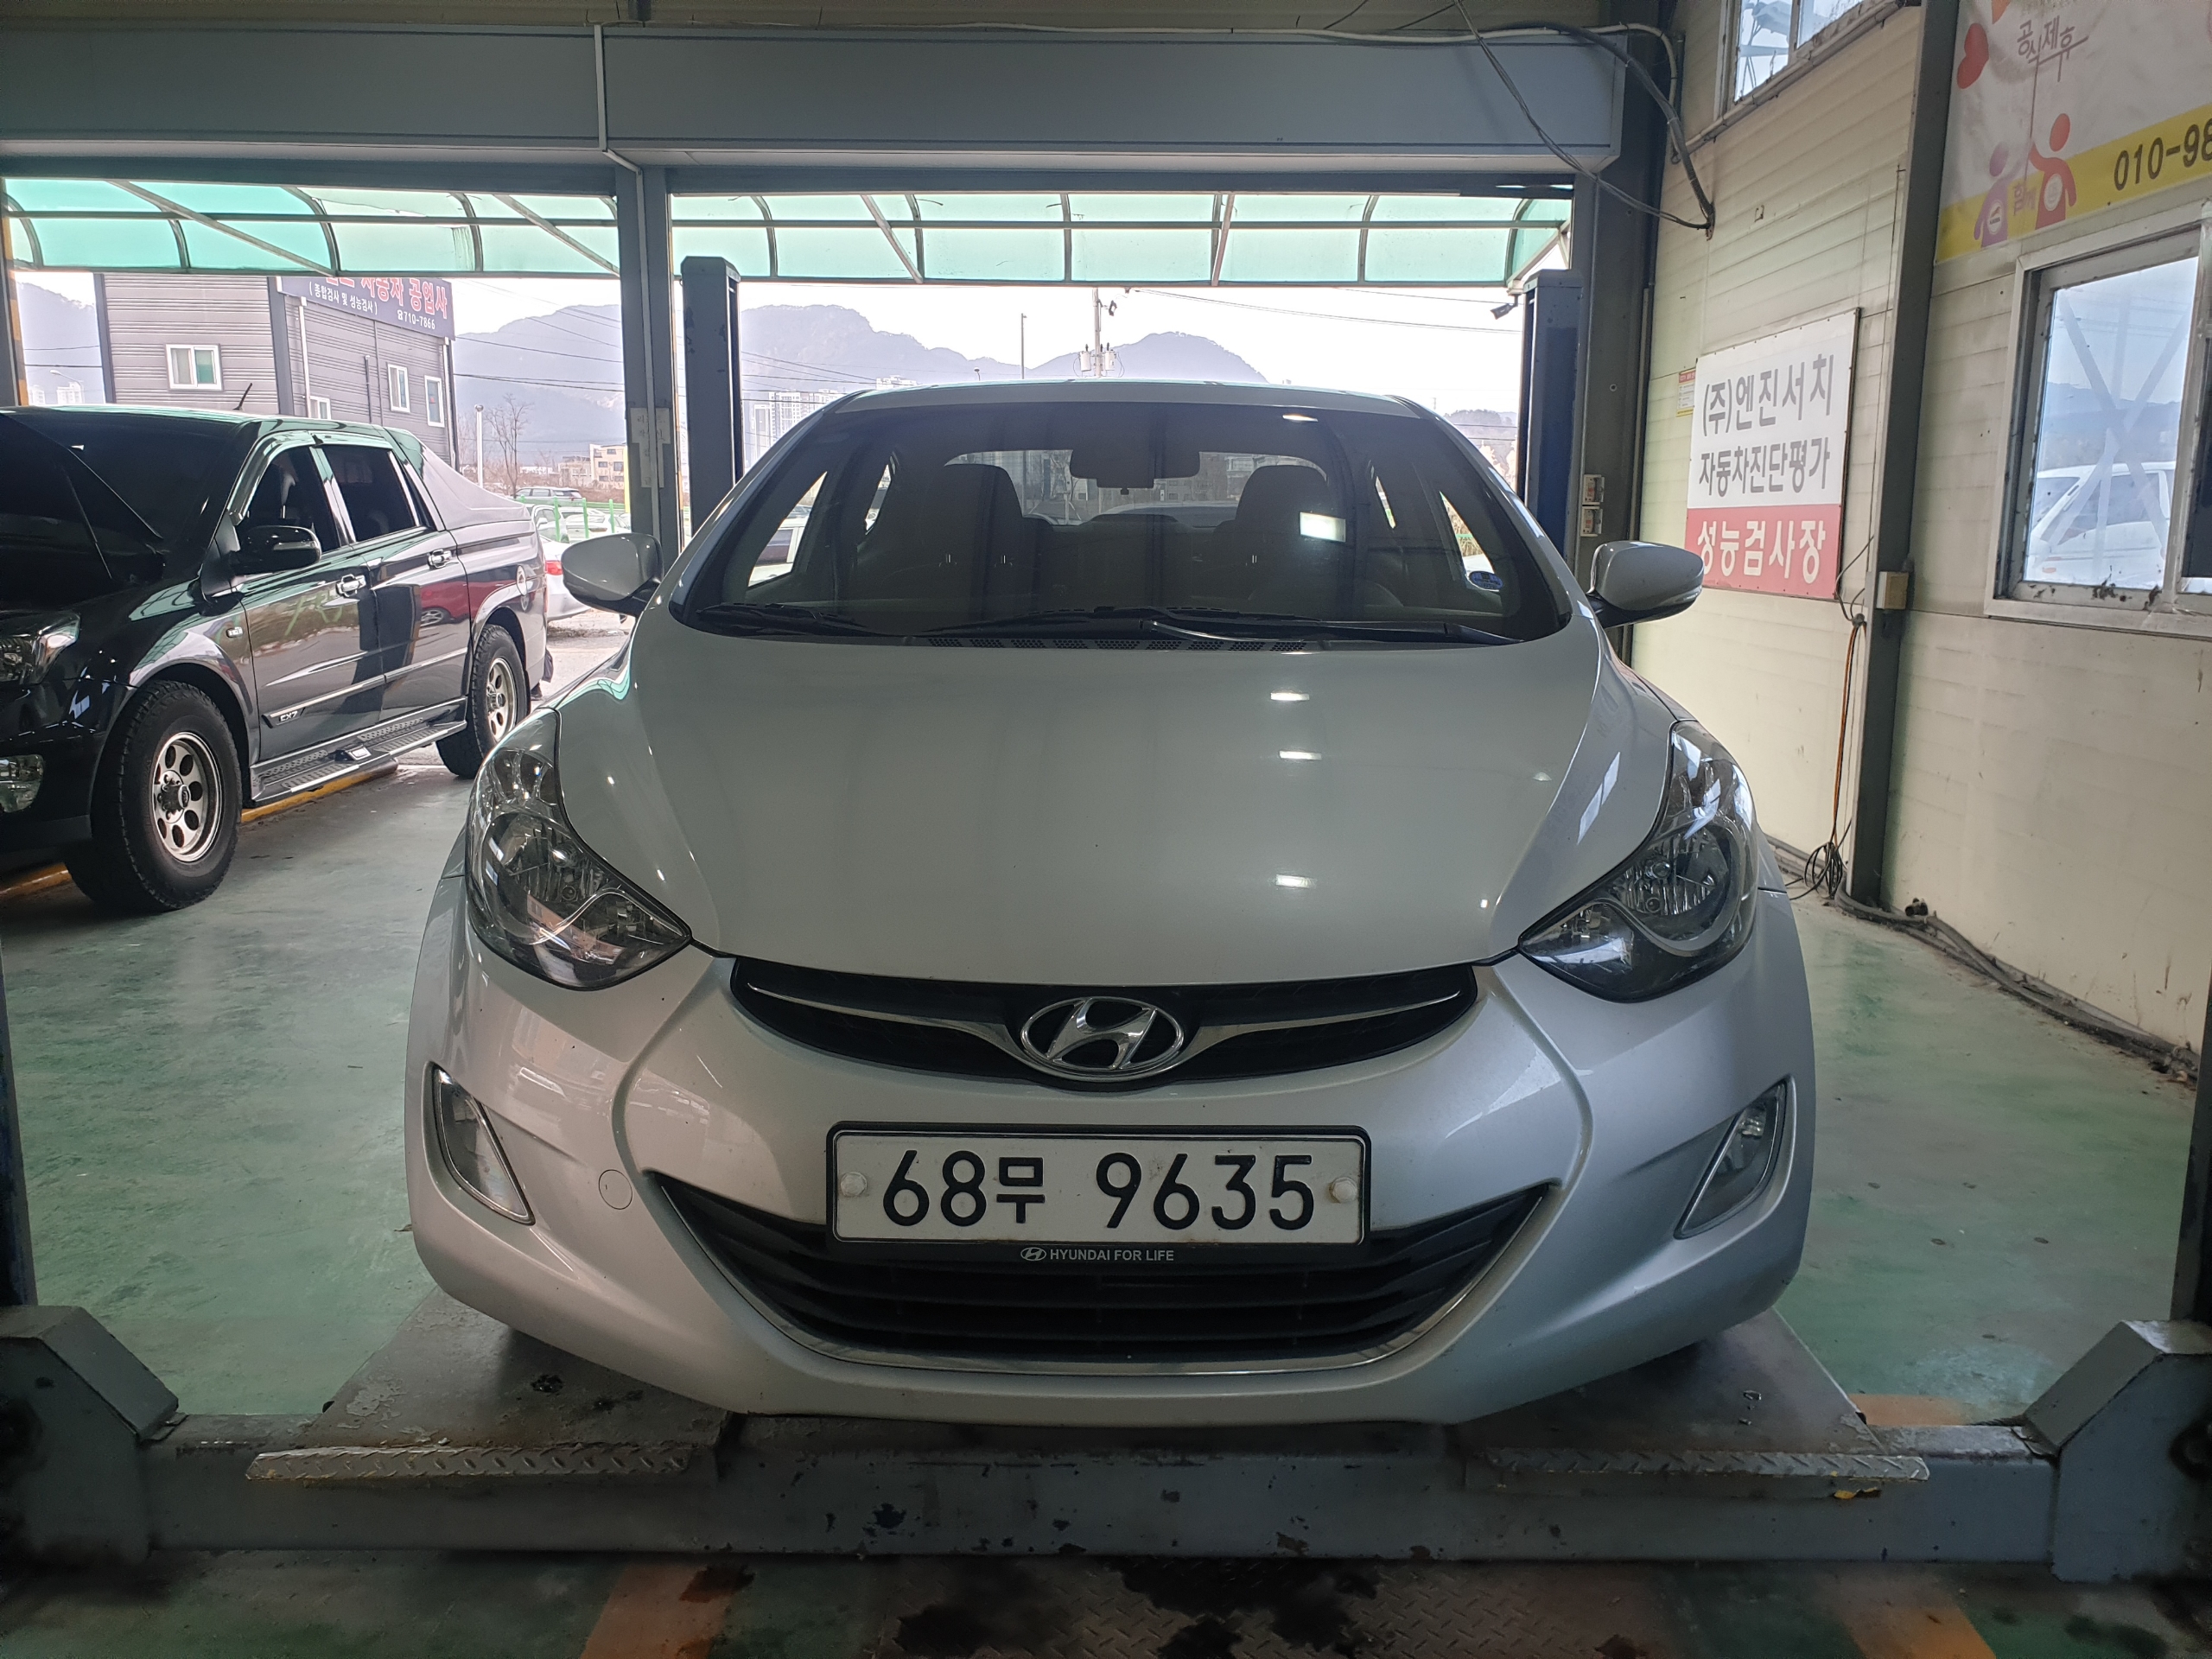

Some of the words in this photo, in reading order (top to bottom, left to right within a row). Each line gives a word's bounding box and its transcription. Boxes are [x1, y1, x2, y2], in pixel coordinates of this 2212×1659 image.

[409, 277, 448, 320] 공업사
[1702, 353, 1834, 437] (주)엔진서치
[1699, 436, 1830, 498] 자동차진단평가
[1697, 520, 1827, 584] 성능검사장
[883, 1149, 1046, 1227] 68무
[1096, 1152, 1315, 1230] 9635
[1050, 1249, 1110, 1261] HYUNDAI
[1114, 1249, 1142, 1262] FOR
[1147, 1249, 1174, 1262] LIFE
